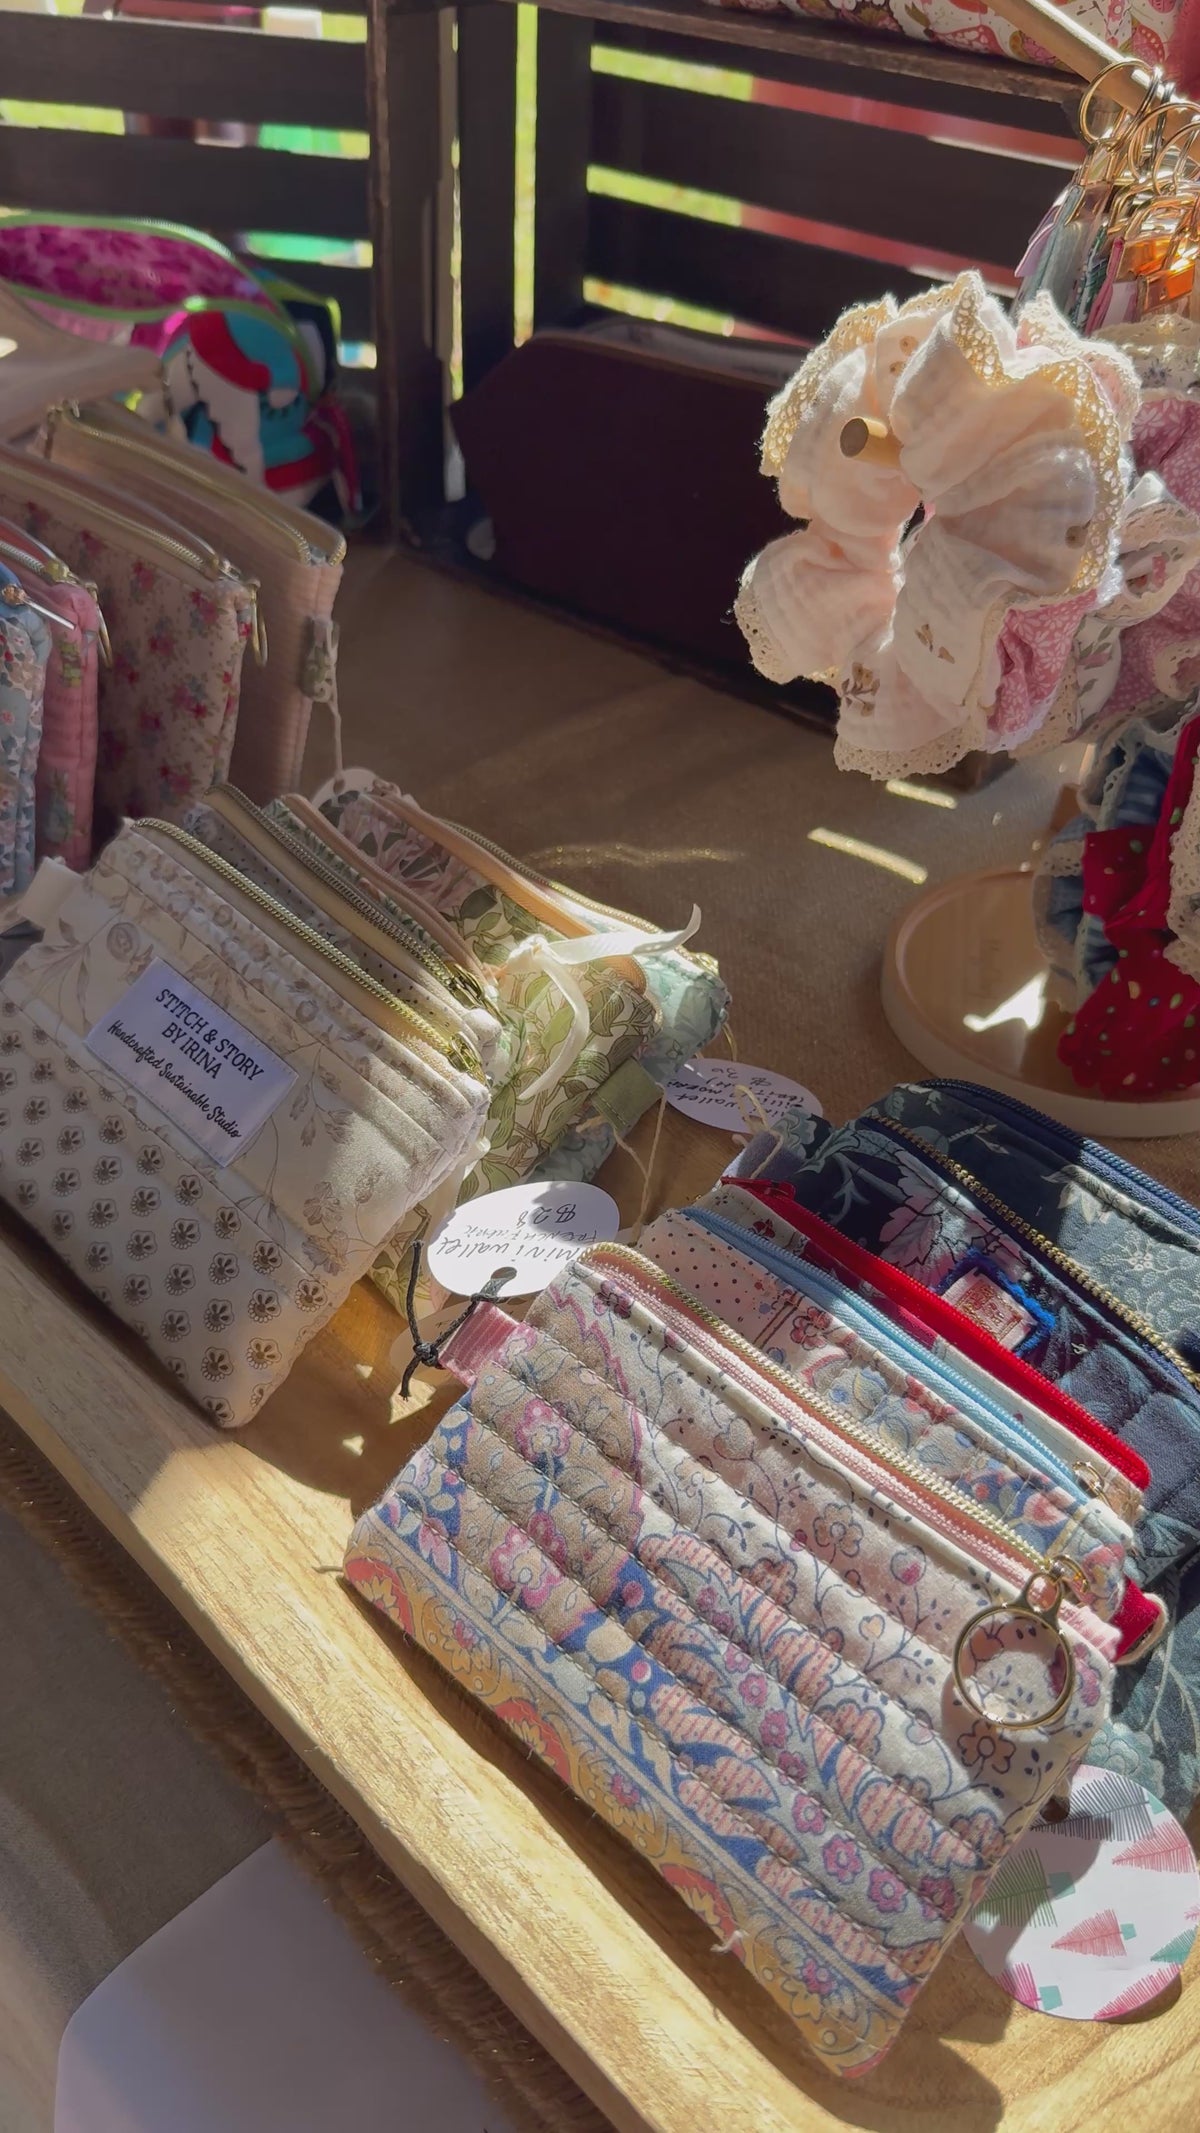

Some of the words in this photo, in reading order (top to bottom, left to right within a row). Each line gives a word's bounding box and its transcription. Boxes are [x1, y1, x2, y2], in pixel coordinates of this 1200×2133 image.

[155, 988, 207, 1035] STITCH
[202, 1028, 218, 1046] &
[214, 1037, 265, 1082] STORY
[161, 1021, 185, 1045] BY
[179, 1037, 222, 1080] IRINA
[107, 1019, 164, 1070] Handcrafted
[158, 1062, 211, 1114] Sustainable
[206, 1105, 243, 1139] Studio
[435, 1236, 511, 1259] wallet
